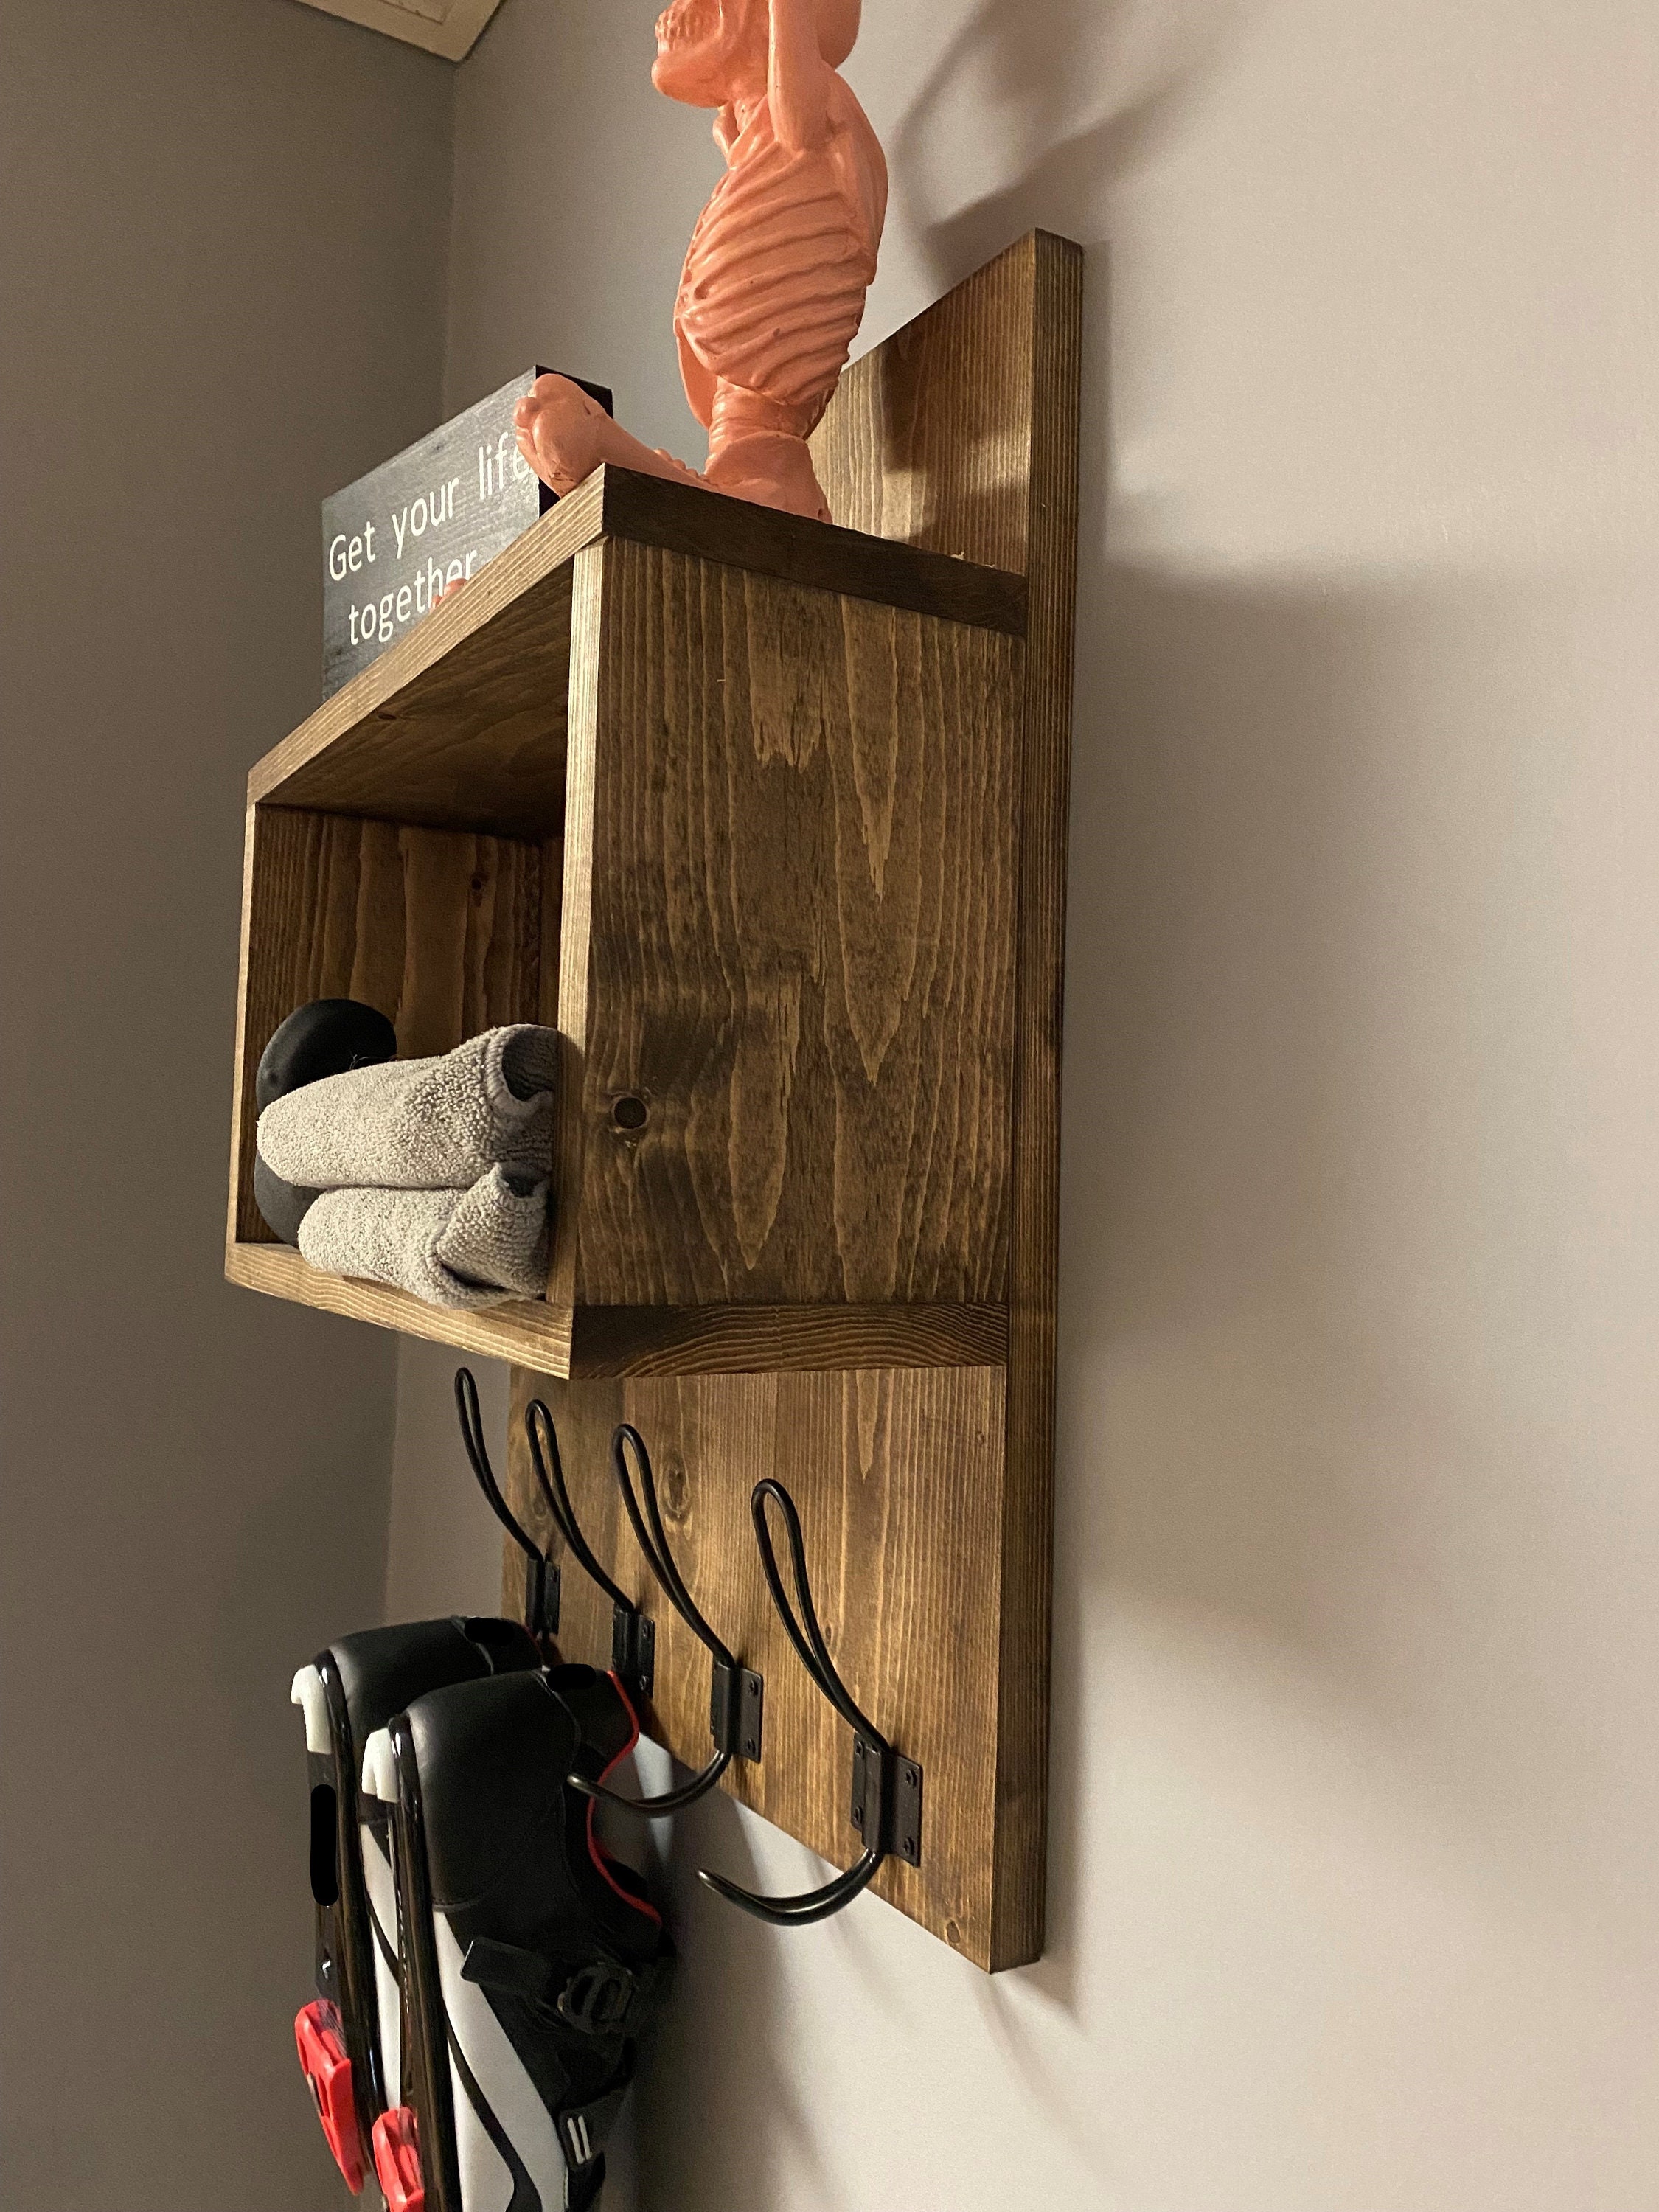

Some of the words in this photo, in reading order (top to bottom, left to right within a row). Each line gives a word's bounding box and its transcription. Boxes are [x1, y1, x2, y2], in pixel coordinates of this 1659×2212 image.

[329, 521, 375, 581] Get
[392, 478, 459, 559] your
[479, 431, 530, 500] life
[349, 549, 477, 645] together
